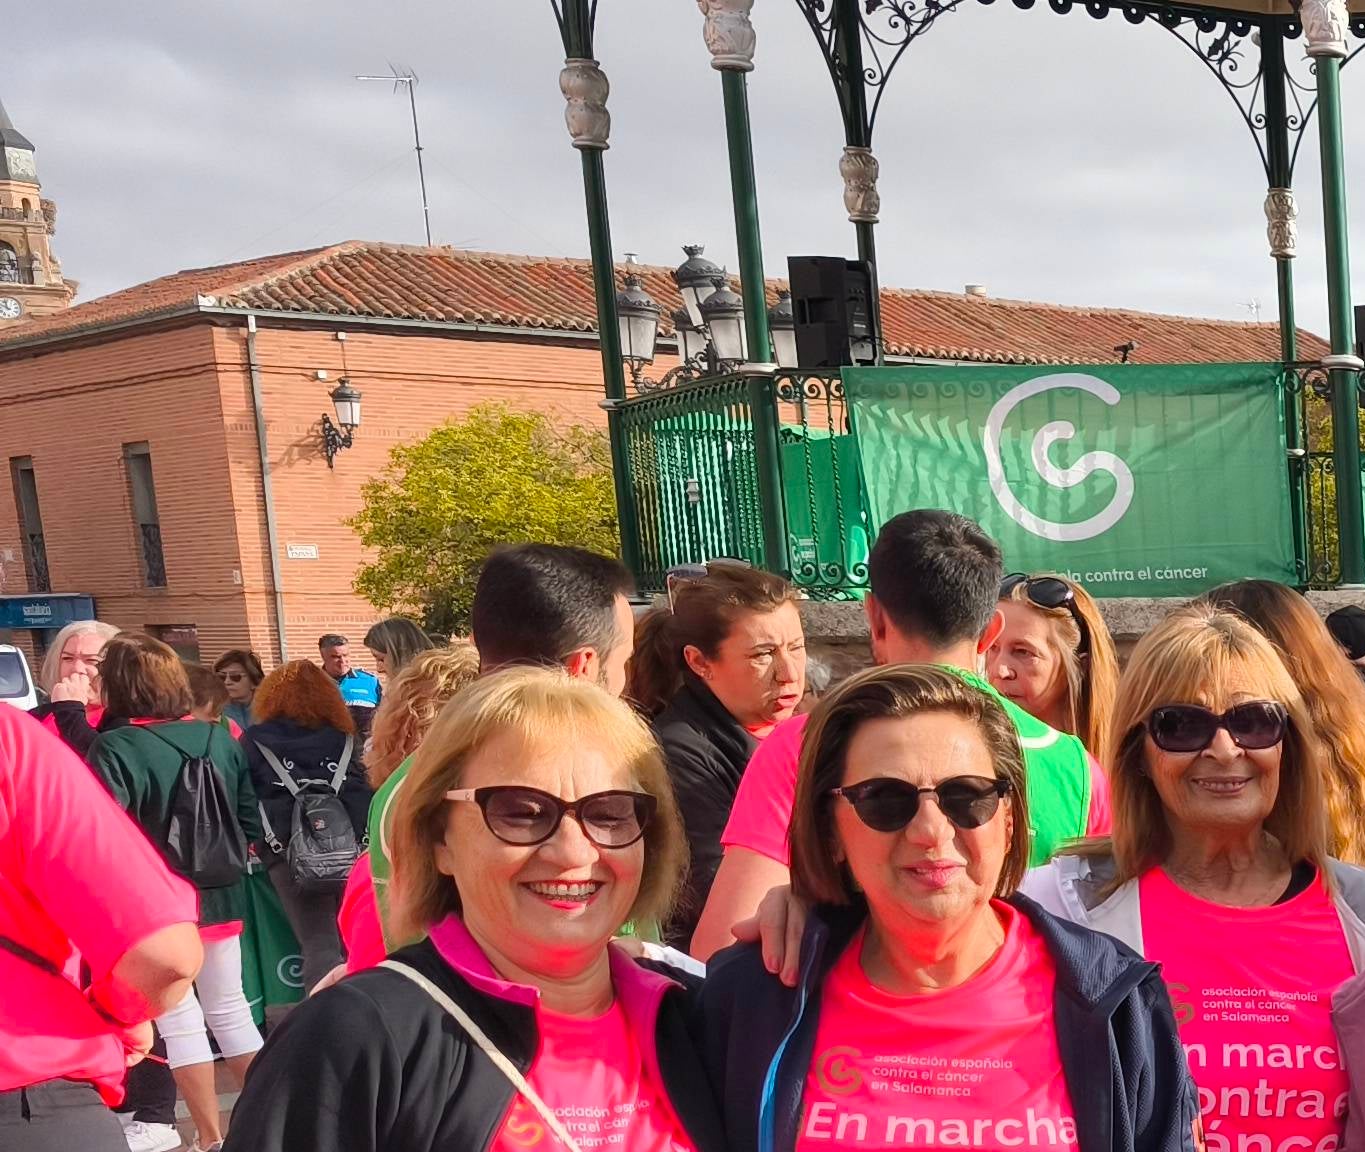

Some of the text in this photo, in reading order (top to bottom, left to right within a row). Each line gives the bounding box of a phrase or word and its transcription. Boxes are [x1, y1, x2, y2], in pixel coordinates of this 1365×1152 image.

[1086, 568, 1134, 582] contra
[1138, 567, 1151, 580] el
[1155, 566, 1208, 580] cáncer
[1202, 987, 1266, 998] asociación
[1203, 999, 1242, 1010] contra
[1245, 1000, 1255, 1010] el
[1203, 1011, 1290, 1024] en Salamanca
[874, 1055, 1014, 1071] asociación española
[872, 1066, 984, 1084] contra el cáncer
[871, 1081, 972, 1097] en Salamanca
[1197, 1079, 1325, 1120] ontra
[805, 1102, 1079, 1147] En marcha
